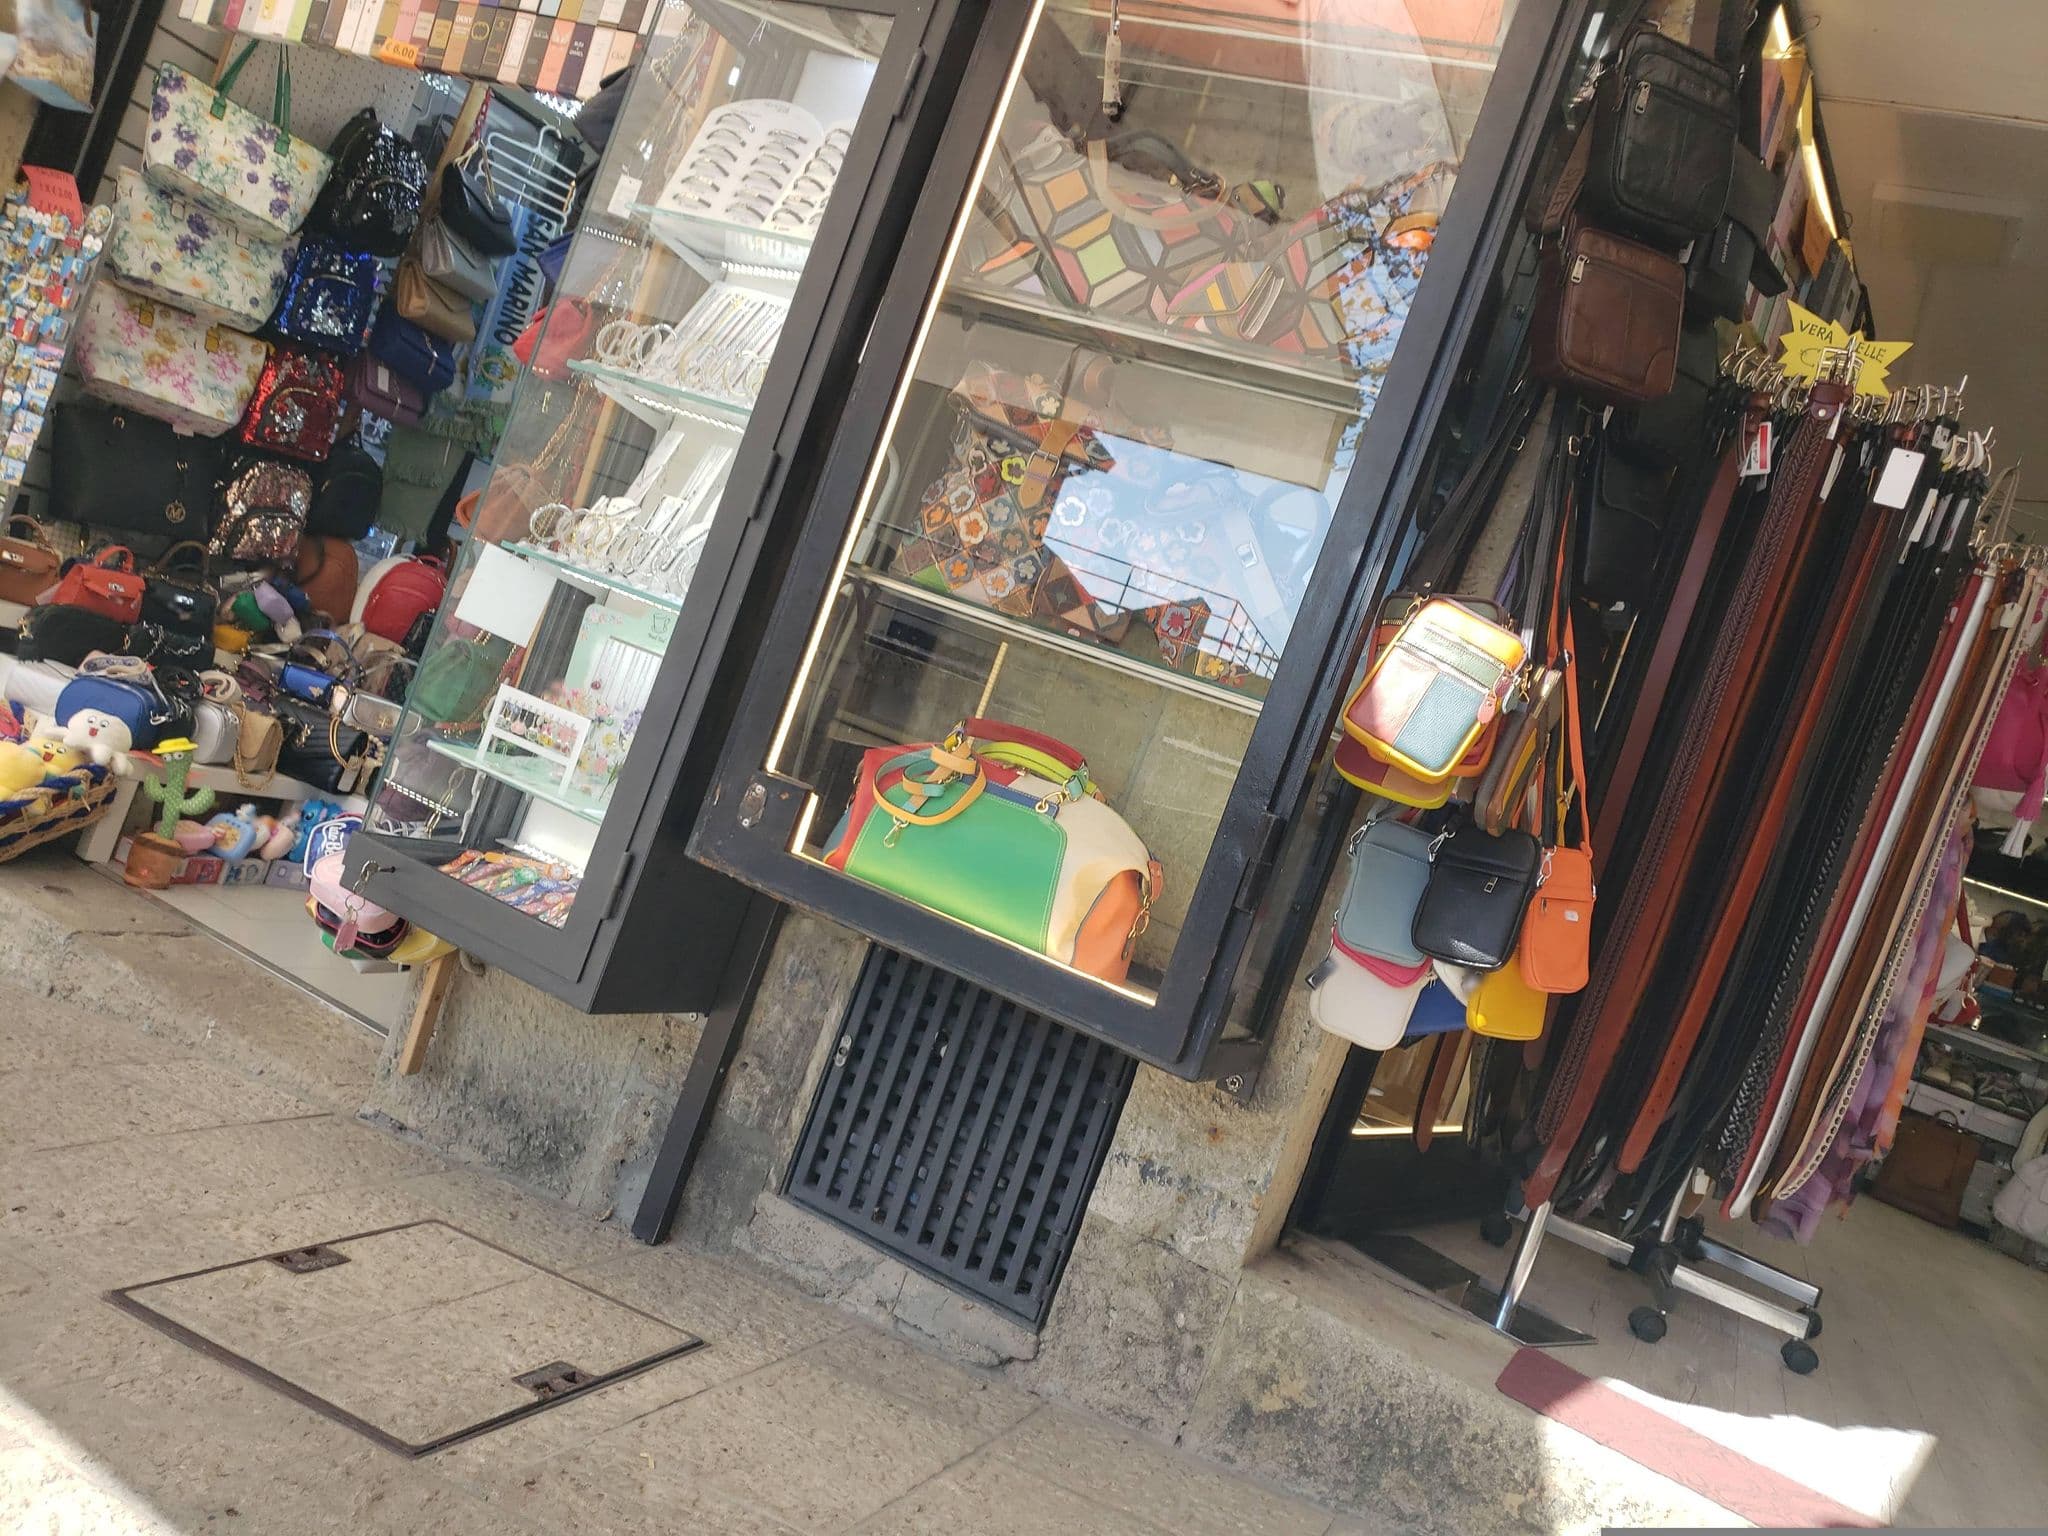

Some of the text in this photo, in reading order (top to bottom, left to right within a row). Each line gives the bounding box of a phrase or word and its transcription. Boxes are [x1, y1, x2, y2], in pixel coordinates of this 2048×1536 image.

[493, 213, 554, 346] SAN MARINO
[1800, 319, 1887, 364] VERA ELLE
